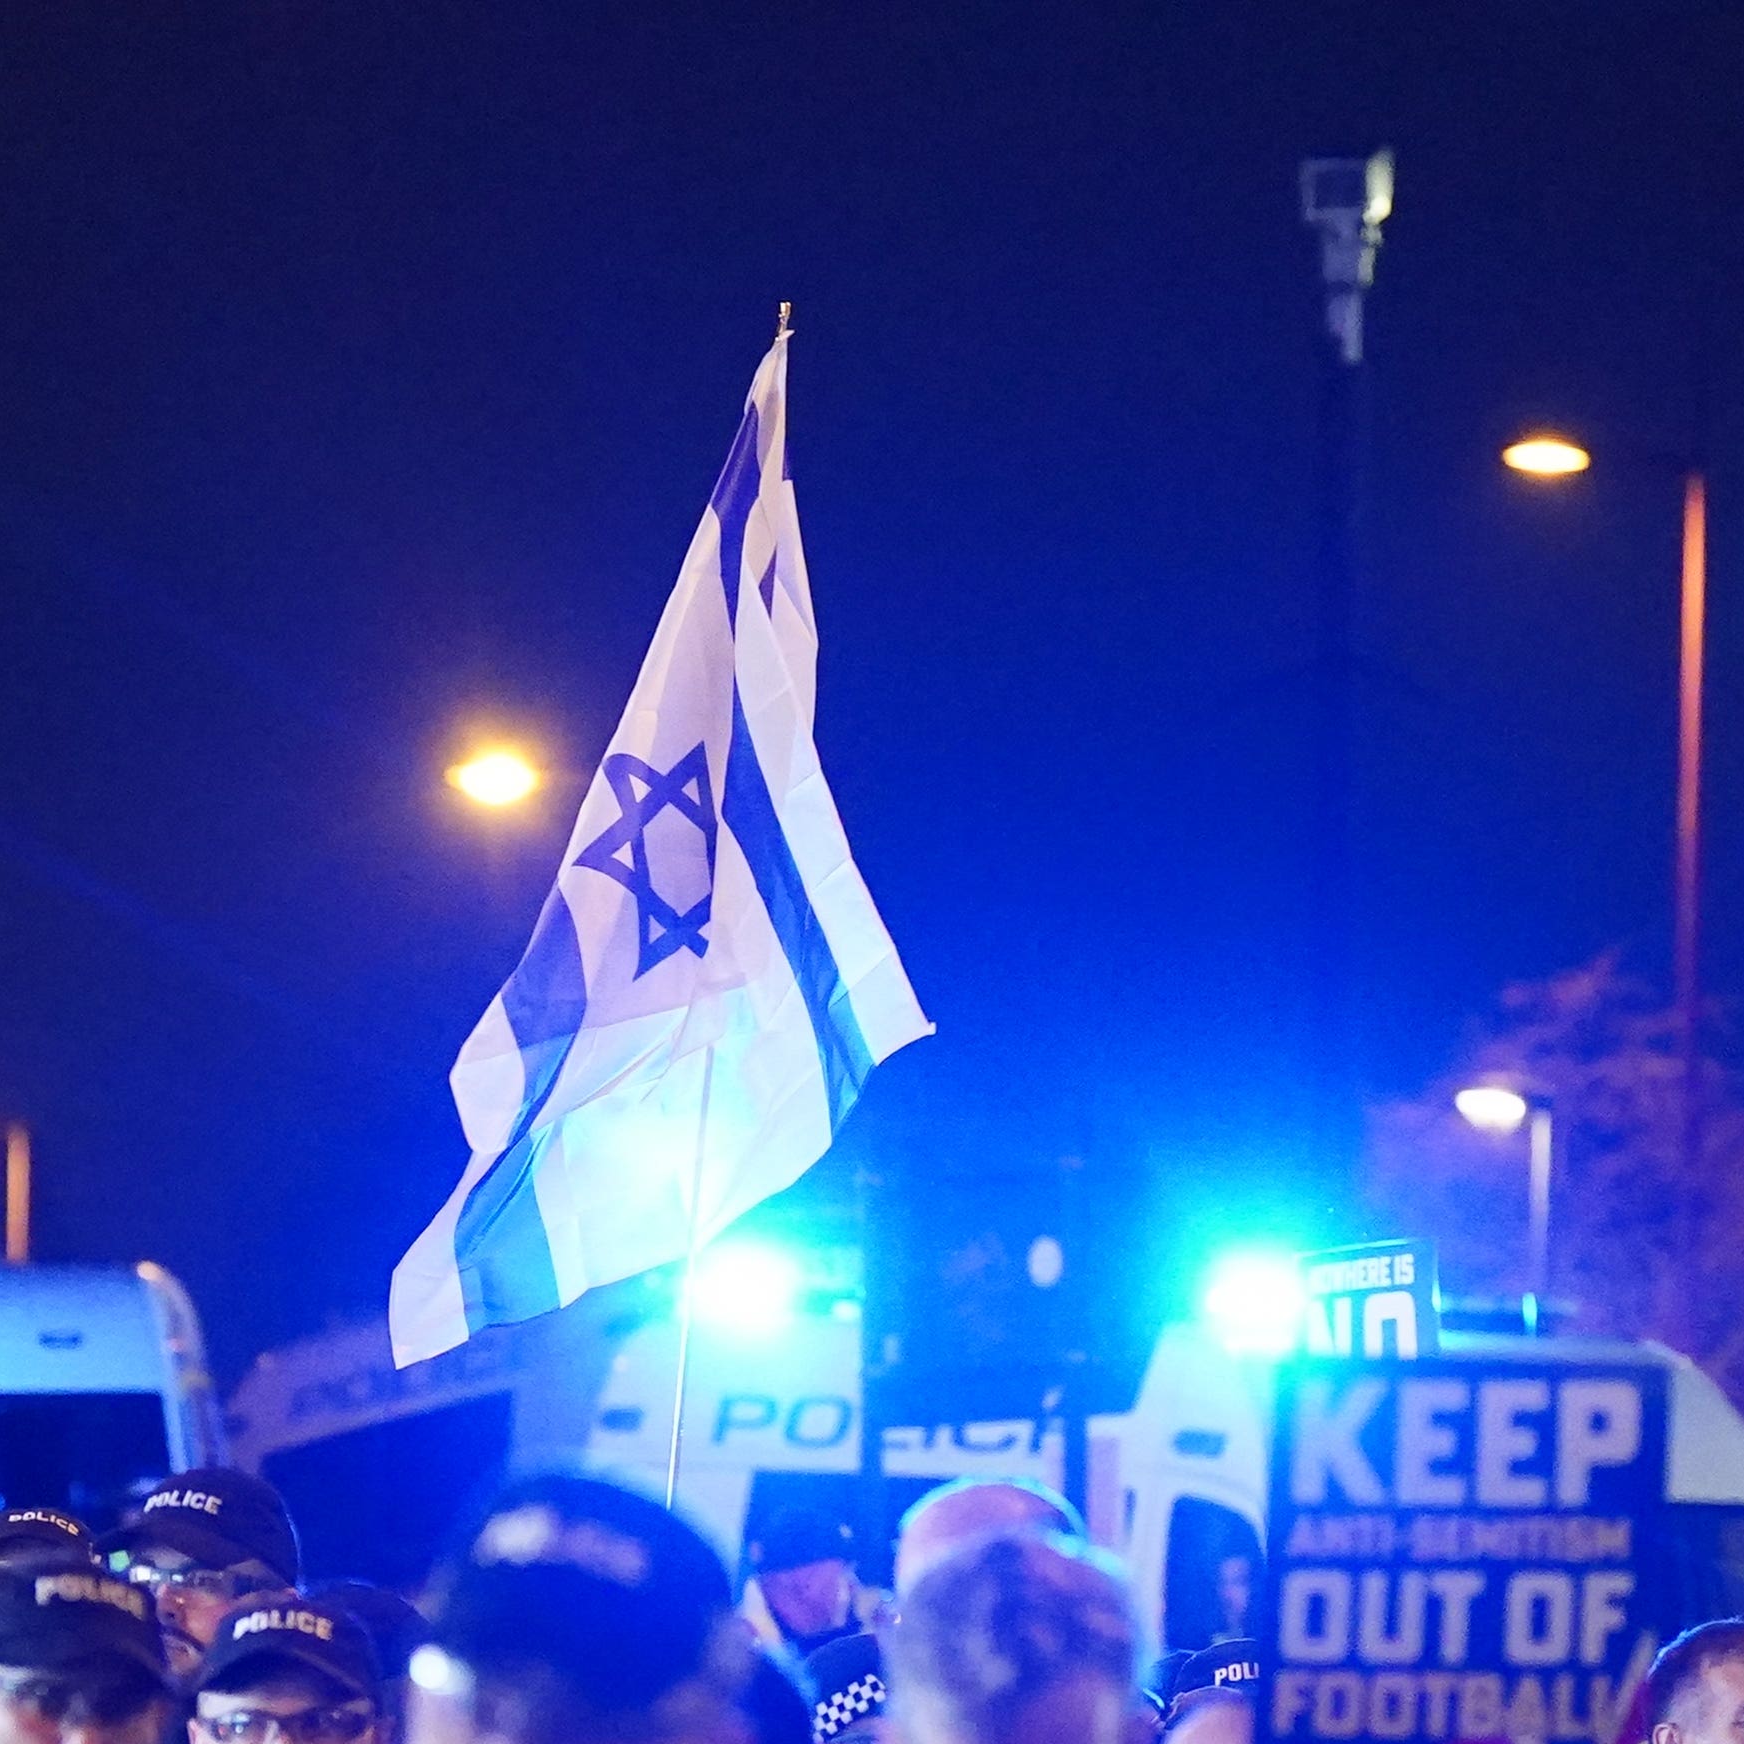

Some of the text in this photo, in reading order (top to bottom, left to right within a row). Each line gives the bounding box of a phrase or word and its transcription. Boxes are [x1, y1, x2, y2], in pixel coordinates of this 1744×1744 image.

[1393, 1253, 1415, 1285] IS
[1293, 1378, 1643, 1508] KEEP
[143, 1488, 223, 1518] POLICE
[7, 1511, 81, 1537] POLICE
[232, 1608, 335, 1641] POLICE
[1280, 1570, 1635, 1667] OUT OF
[1214, 1661, 1260, 1687] POLI
[1271, 1669, 1619, 1740] FOOTBALL
